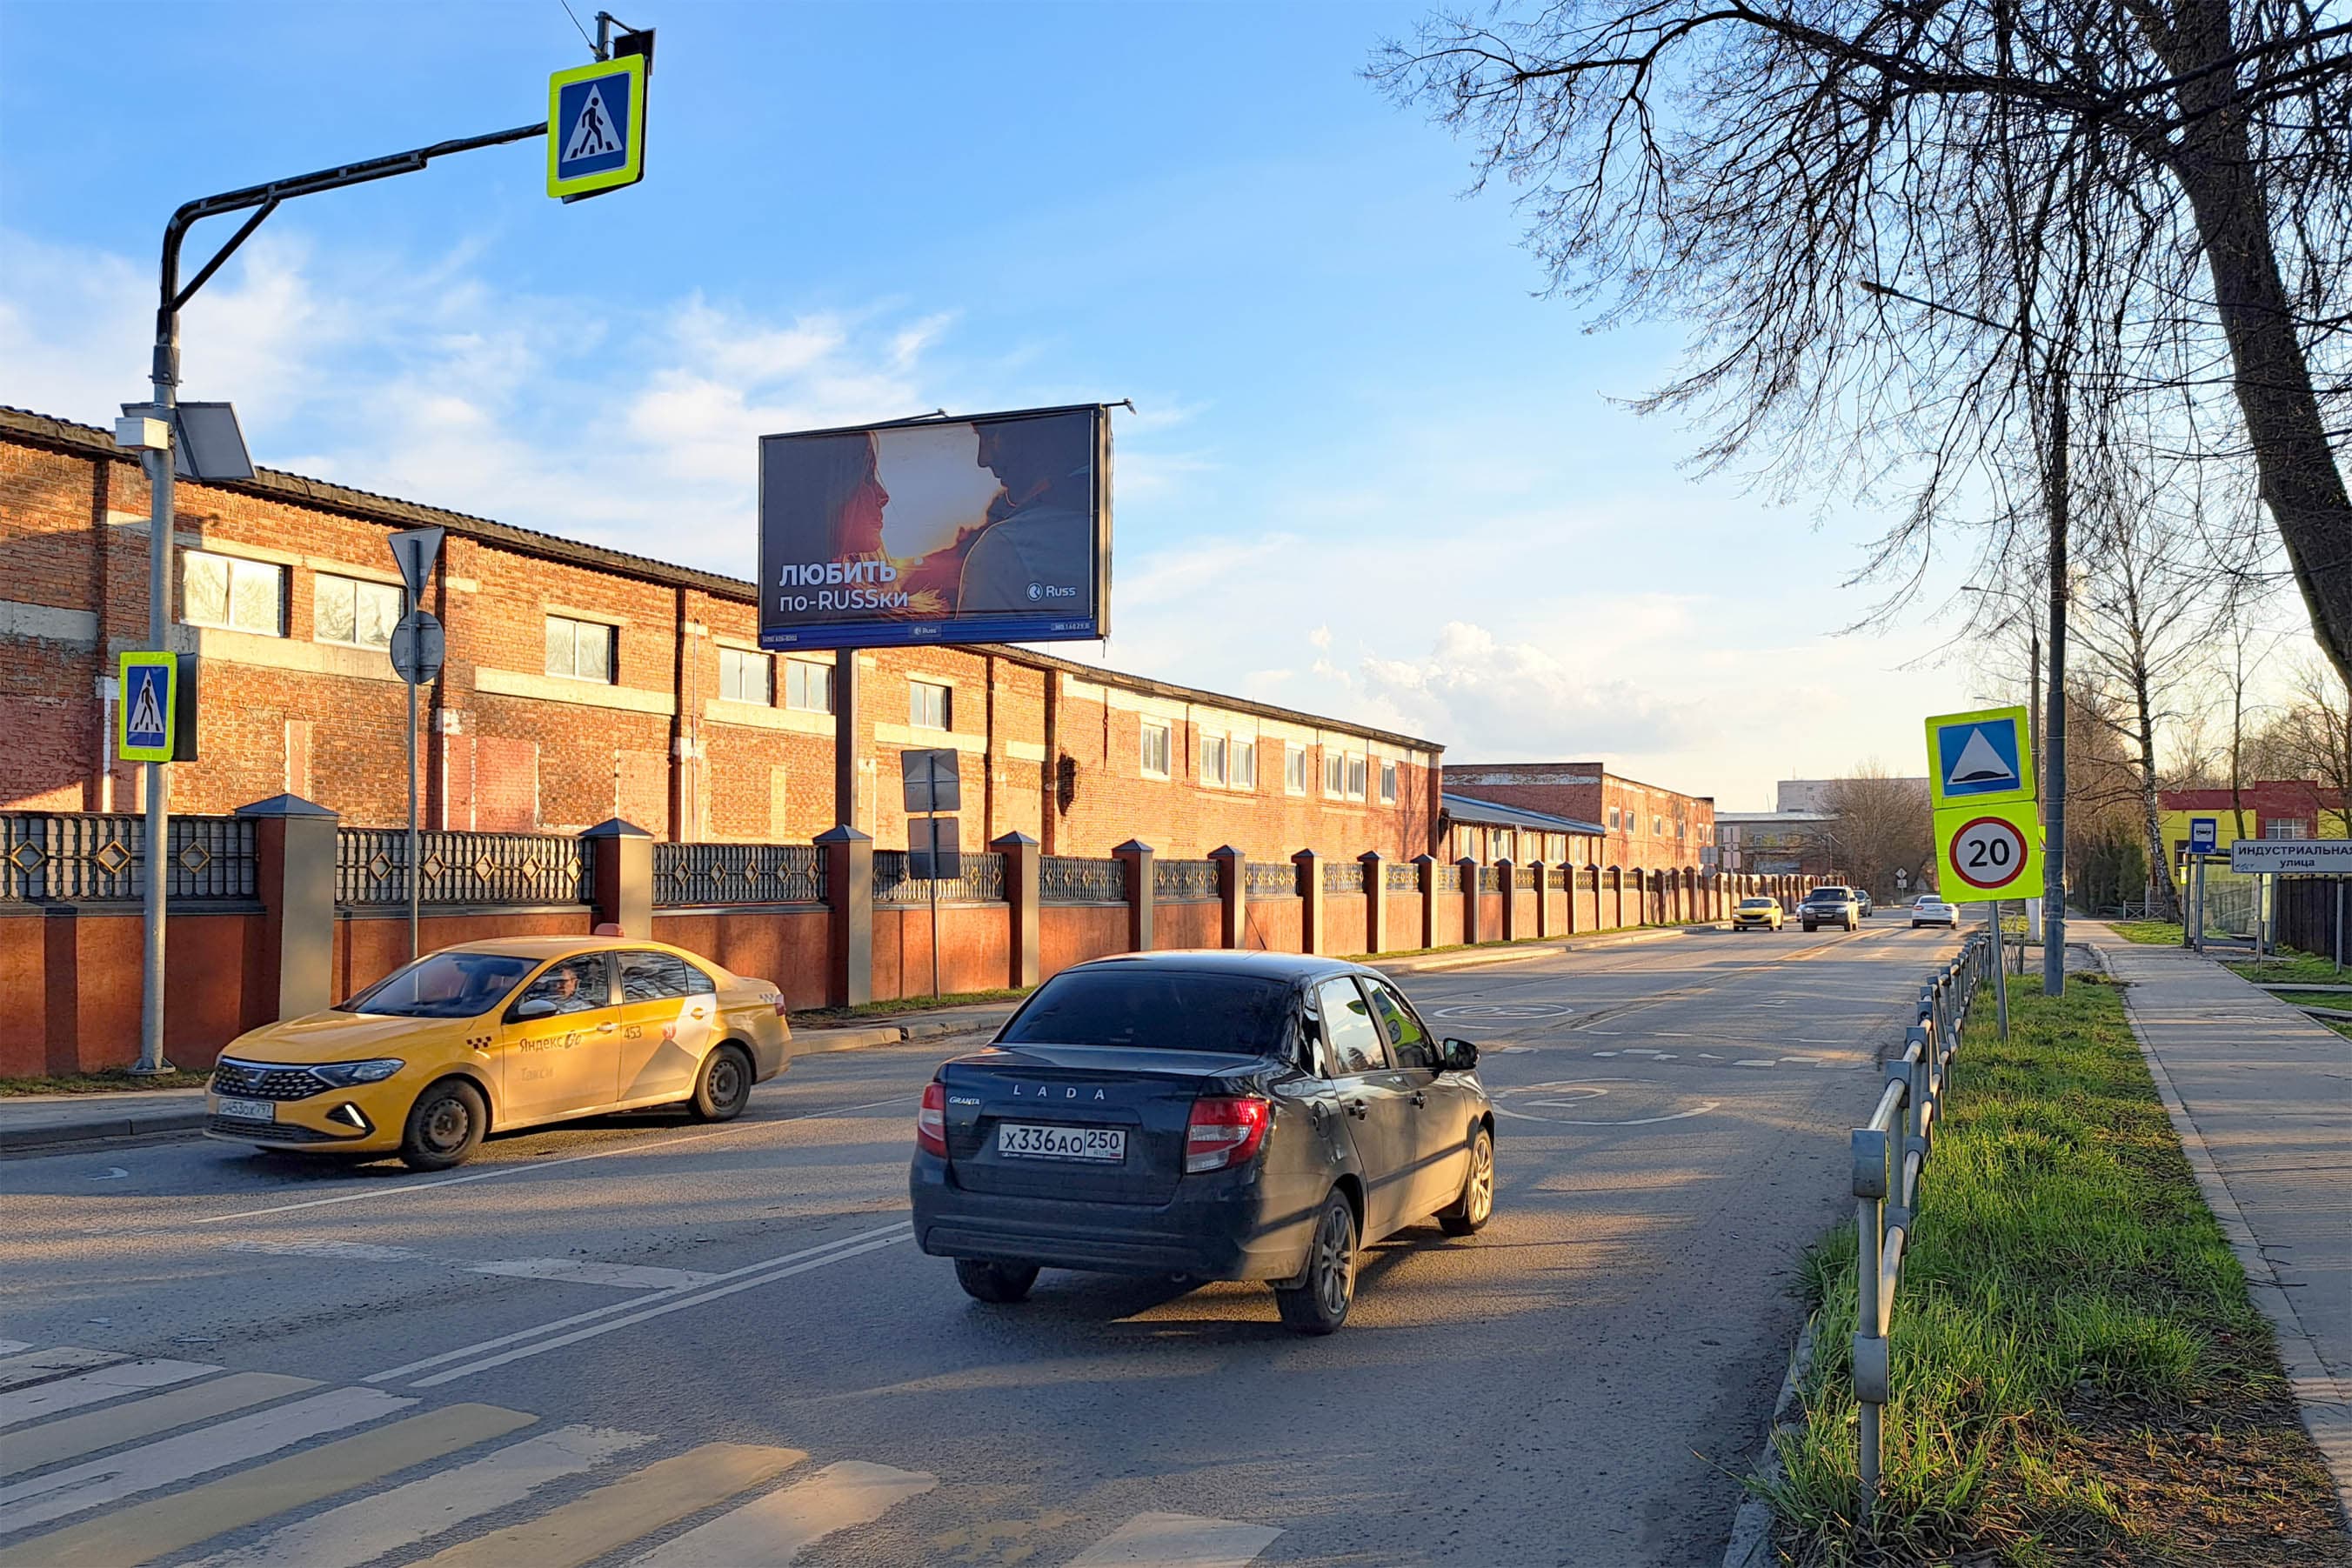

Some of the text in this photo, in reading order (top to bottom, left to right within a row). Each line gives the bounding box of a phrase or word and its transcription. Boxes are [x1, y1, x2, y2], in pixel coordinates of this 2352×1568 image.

[778, 561, 897, 587] ЛЮБИТЬ
[779, 589, 908, 611] по-RUSSки
[1046, 585, 1077, 597] Russ
[1968, 837, 2010, 867] 20
[2280, 859, 2315, 869] улица
[519, 1030, 582, 1053] Яндекс Go
[624, 1025, 642, 1040] 453
[1012, 1084, 1105, 1100] LADA
